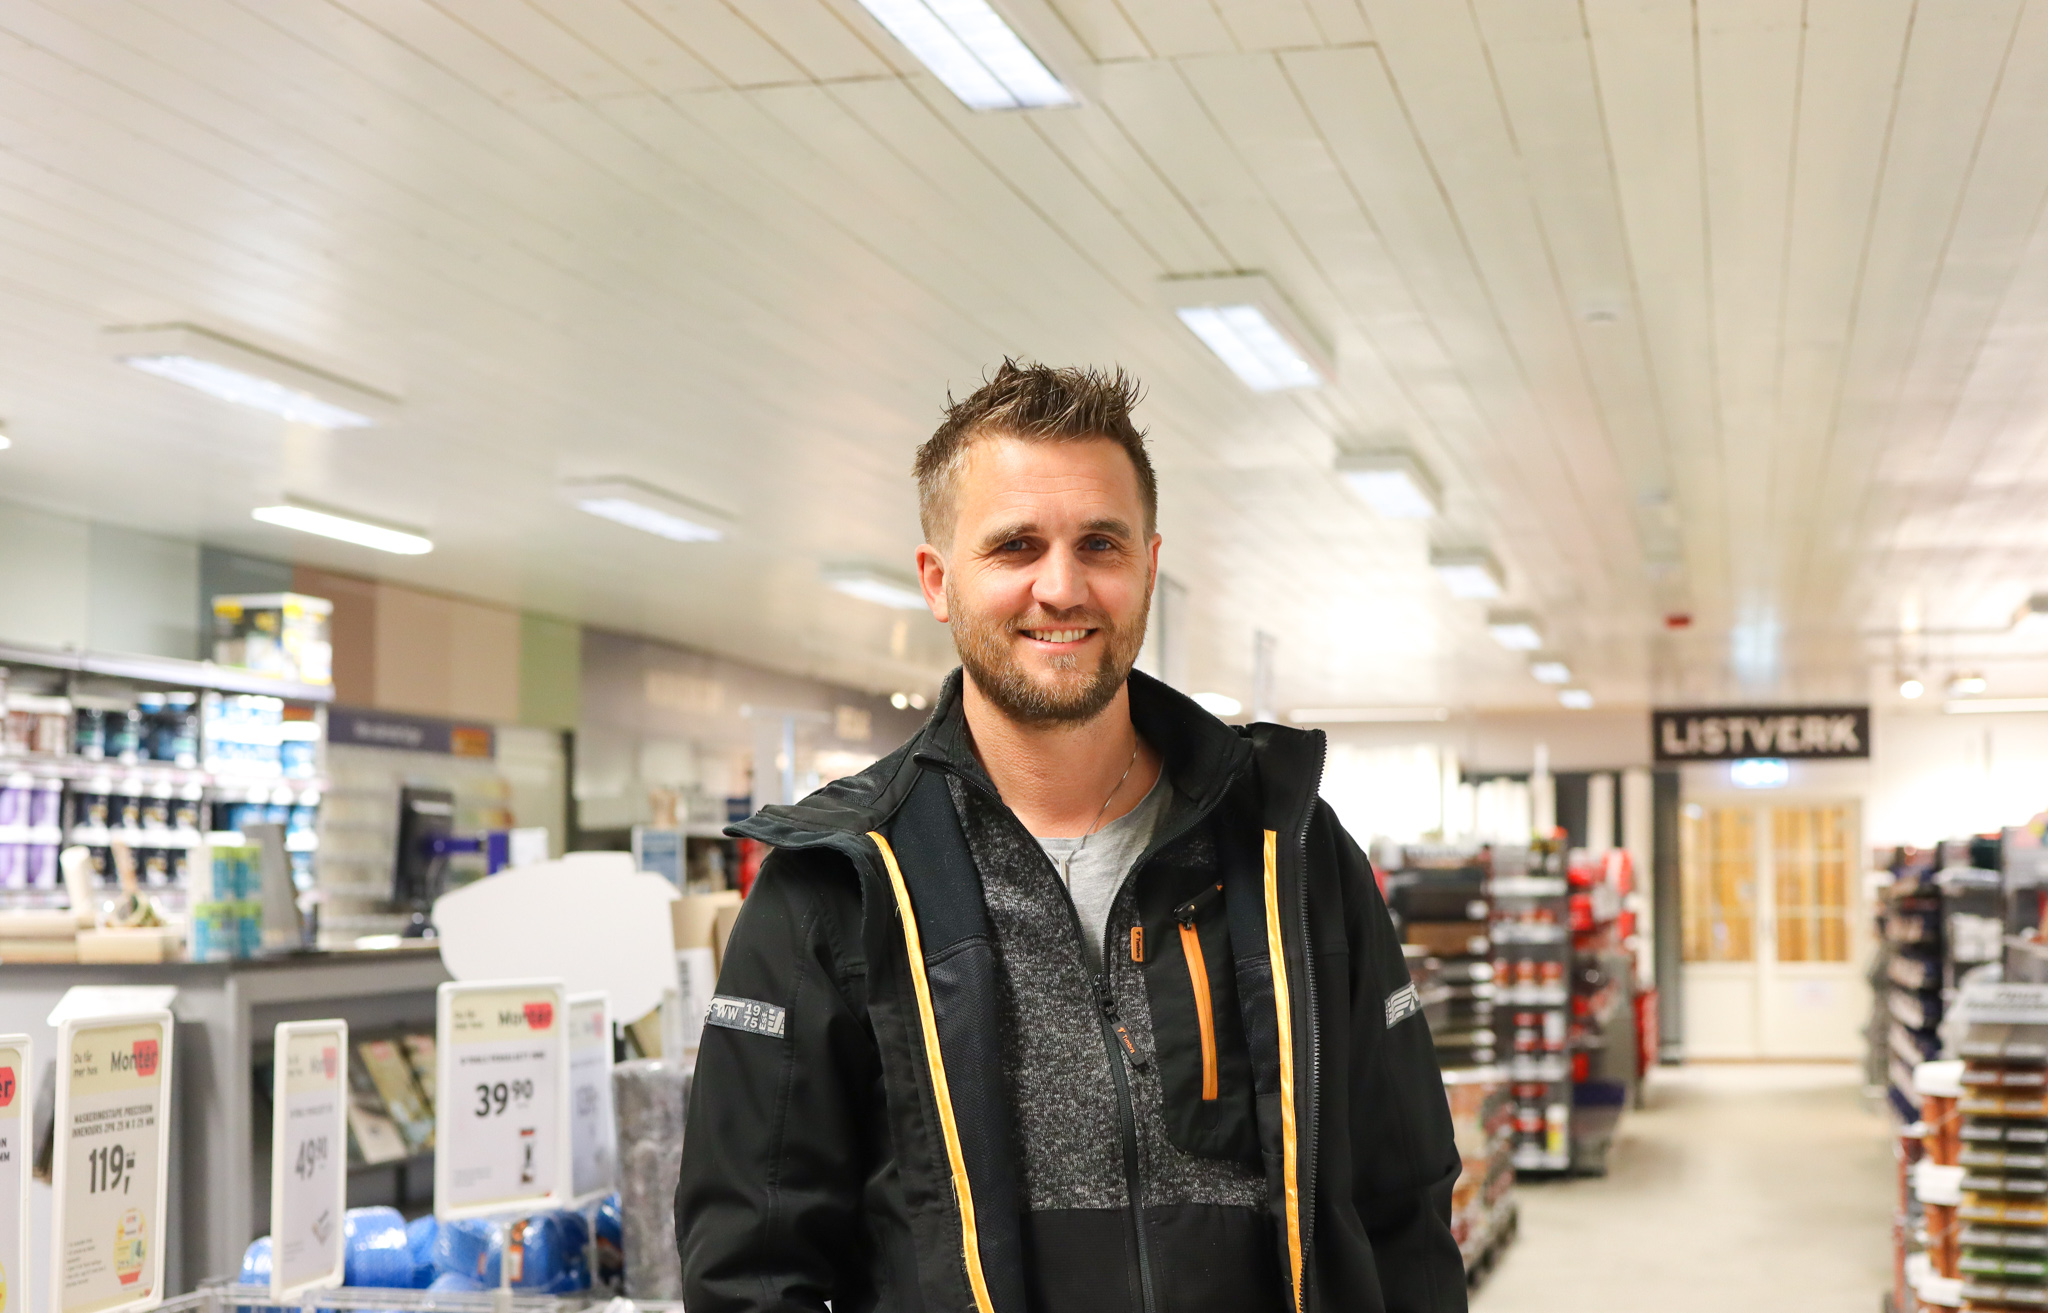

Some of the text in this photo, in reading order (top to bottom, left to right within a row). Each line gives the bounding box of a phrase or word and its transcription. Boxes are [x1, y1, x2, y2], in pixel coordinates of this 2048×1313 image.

[1662, 714, 1860, 755] LISTVERK
[745, 1003, 761, 1017] 19
[743, 1015, 759, 1030] 75
[1122, 1034, 1135, 1054] Timbra
